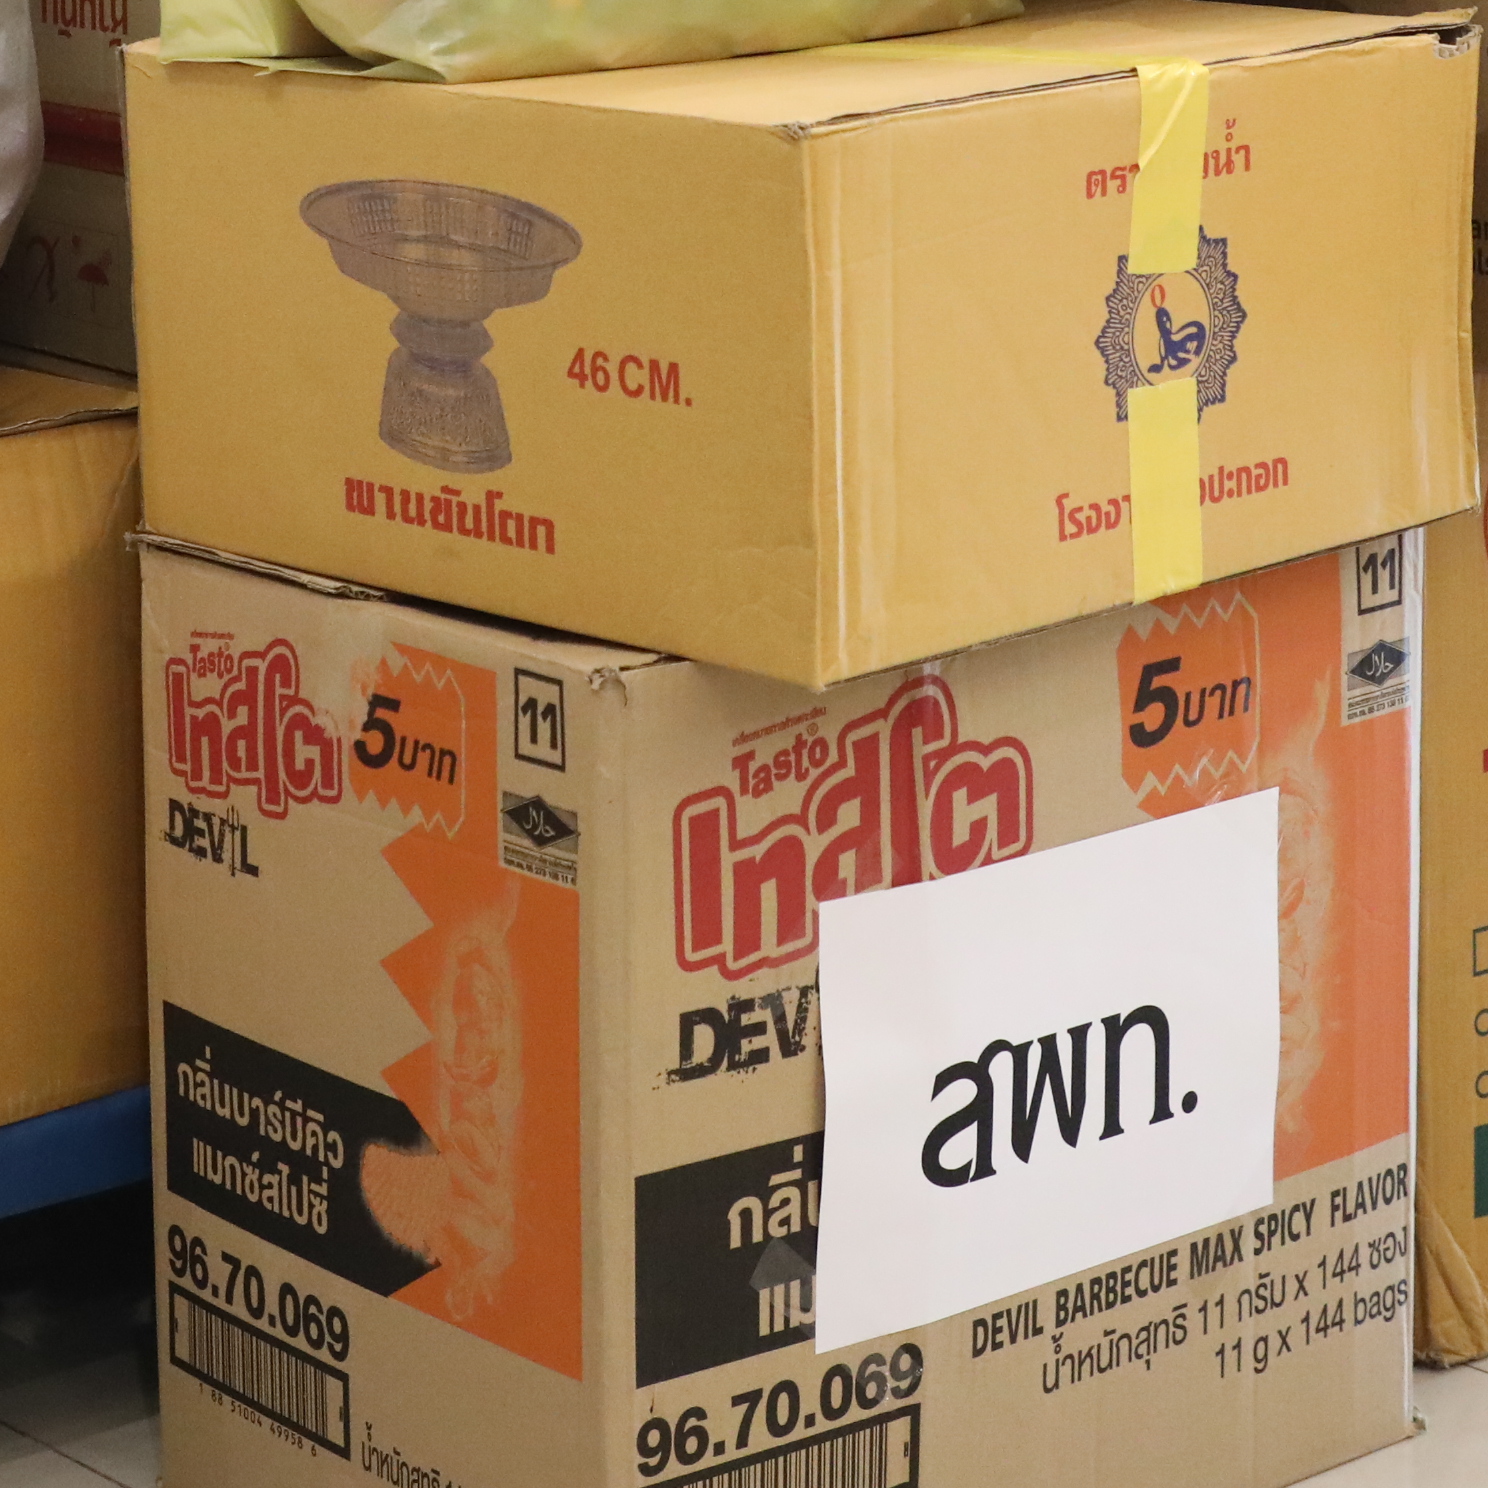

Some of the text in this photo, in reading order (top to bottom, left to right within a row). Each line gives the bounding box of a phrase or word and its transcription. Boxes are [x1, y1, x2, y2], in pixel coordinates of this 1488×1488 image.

[566, 347, 694, 407] 46 CM.
[343, 476, 556, 556] พานขันโตก
[1362, 547, 1397, 596] 11
[189, 643, 235, 680] Tasto
[520, 696, 559, 752] 11
[731, 732, 830, 800] Tasto
[176, 1045, 345, 1171] กลิ่นบาร์บีคิว
[191, 1135, 329, 1236] แมกซ์สไปซี่
[167, 1223, 351, 1364] 96.70.069
[971, 1162, 1409, 1359] DEVIL BARBECUE MAX SPICY FLAVOR
[1041, 1302, 1189, 1394] น้ำหนักสุทธิ
[1197, 1297, 1226, 1335] 11
[1237, 1272, 1287, 1323] กรัม
[1317, 1242, 1362, 1290] 144
[1367, 1225, 1409, 1270] ซอง
[1214, 1335, 1244, 1379] 11
[1253, 1339, 1270, 1375] g
[1300, 1302, 1347, 1347] 144
[1353, 1276, 1409, 1327] bags
[636, 1342, 925, 1479] 96.70.069
